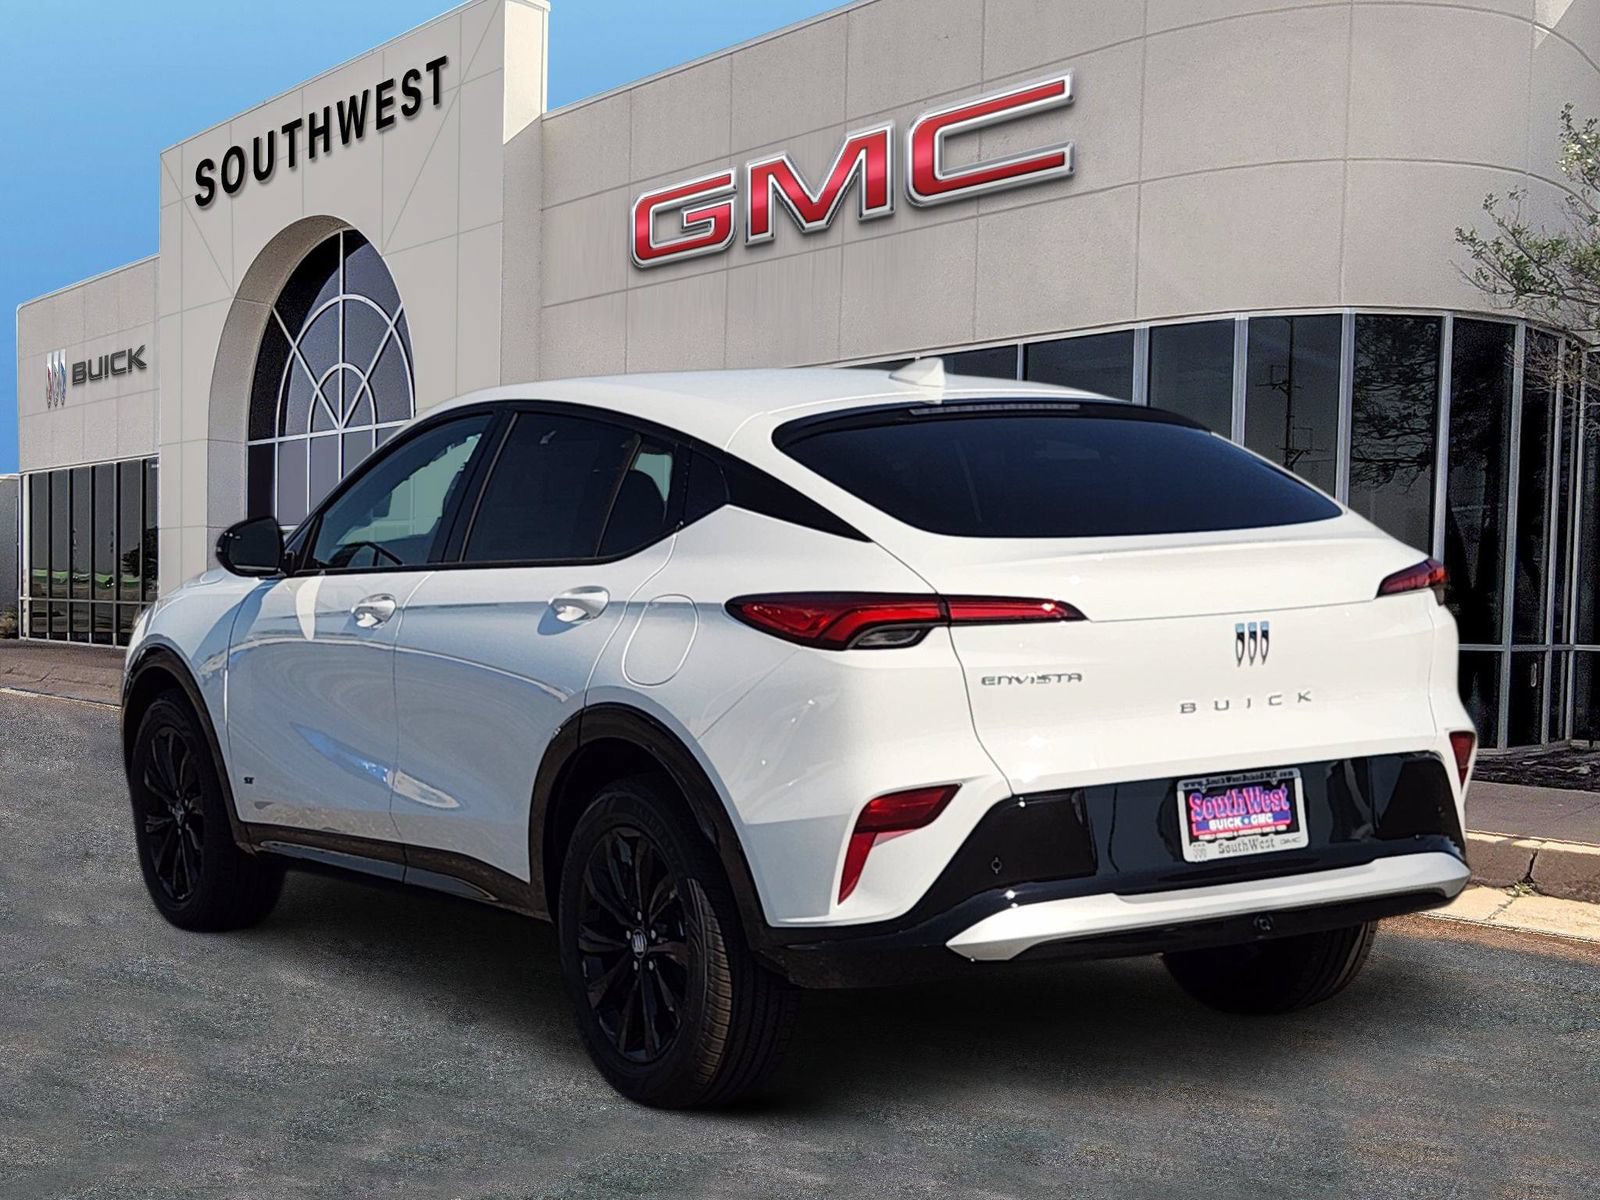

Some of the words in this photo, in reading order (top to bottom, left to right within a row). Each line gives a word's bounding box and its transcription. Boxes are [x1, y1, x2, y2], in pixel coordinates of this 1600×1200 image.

[194, 56, 449, 207] SOUTHWEST
[630, 68, 1075, 269] GMC
[71, 344, 148, 387] BUICK
[981, 672, 1083, 687] ENVISTA
[1180, 691, 1312, 714] BUICK
[1209, 816, 1243, 830] BUICK
[1250, 813, 1274, 825] GMC
[1218, 838, 1275, 854] SouthWest
